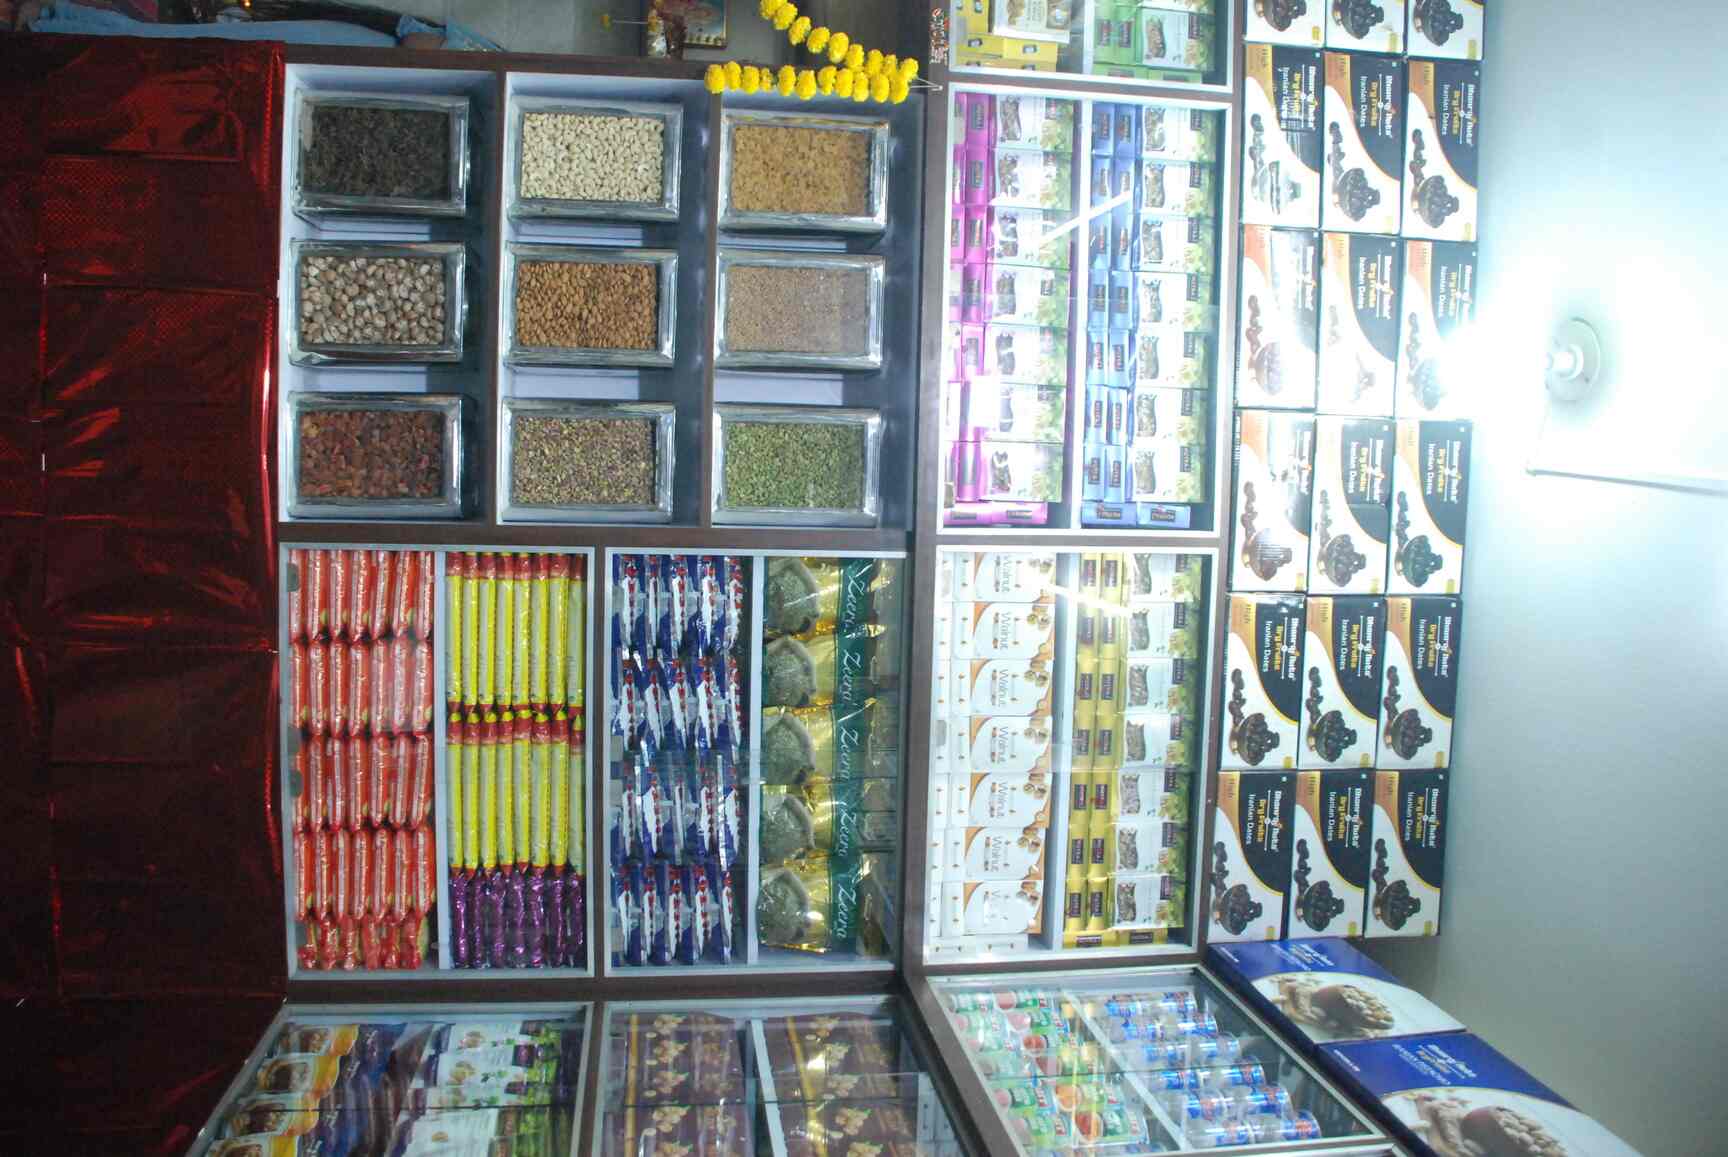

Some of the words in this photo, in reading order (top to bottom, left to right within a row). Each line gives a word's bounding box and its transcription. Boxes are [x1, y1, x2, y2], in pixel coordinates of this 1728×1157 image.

[1442, 86, 1450, 113] Iranian
[1360, 106, 1368, 128] Dates
[1441, 114, 1449, 137] Dates
[999, 612, 1011, 650] Walnut
[1265, 621, 1273, 647] Iranian
[1418, 619, 1426, 645] Iranian
[1263, 649, 1271, 672] Dates
[1339, 647, 1347, 669] Dates
[1417, 647, 1425, 669] Dates
[842, 649, 861, 701] Zeera
[998, 669, 1009, 707] Walnut
[840, 726, 859, 780] Zeera
[997, 726, 1009, 764] Walnut
[996, 782, 1009, 818] Walnut
[1248, 793, 1256, 819] Iranian
[1406, 791, 1414, 817] Iranian
[839, 808, 857, 856] Zeera
[1246, 821, 1254, 843] Dates
[1327, 819, 1335, 840] Dates
[1404, 819, 1412, 840] Dates
[990, 836, 1002, 872] Walnut
[837, 884, 856, 938] Zeera
